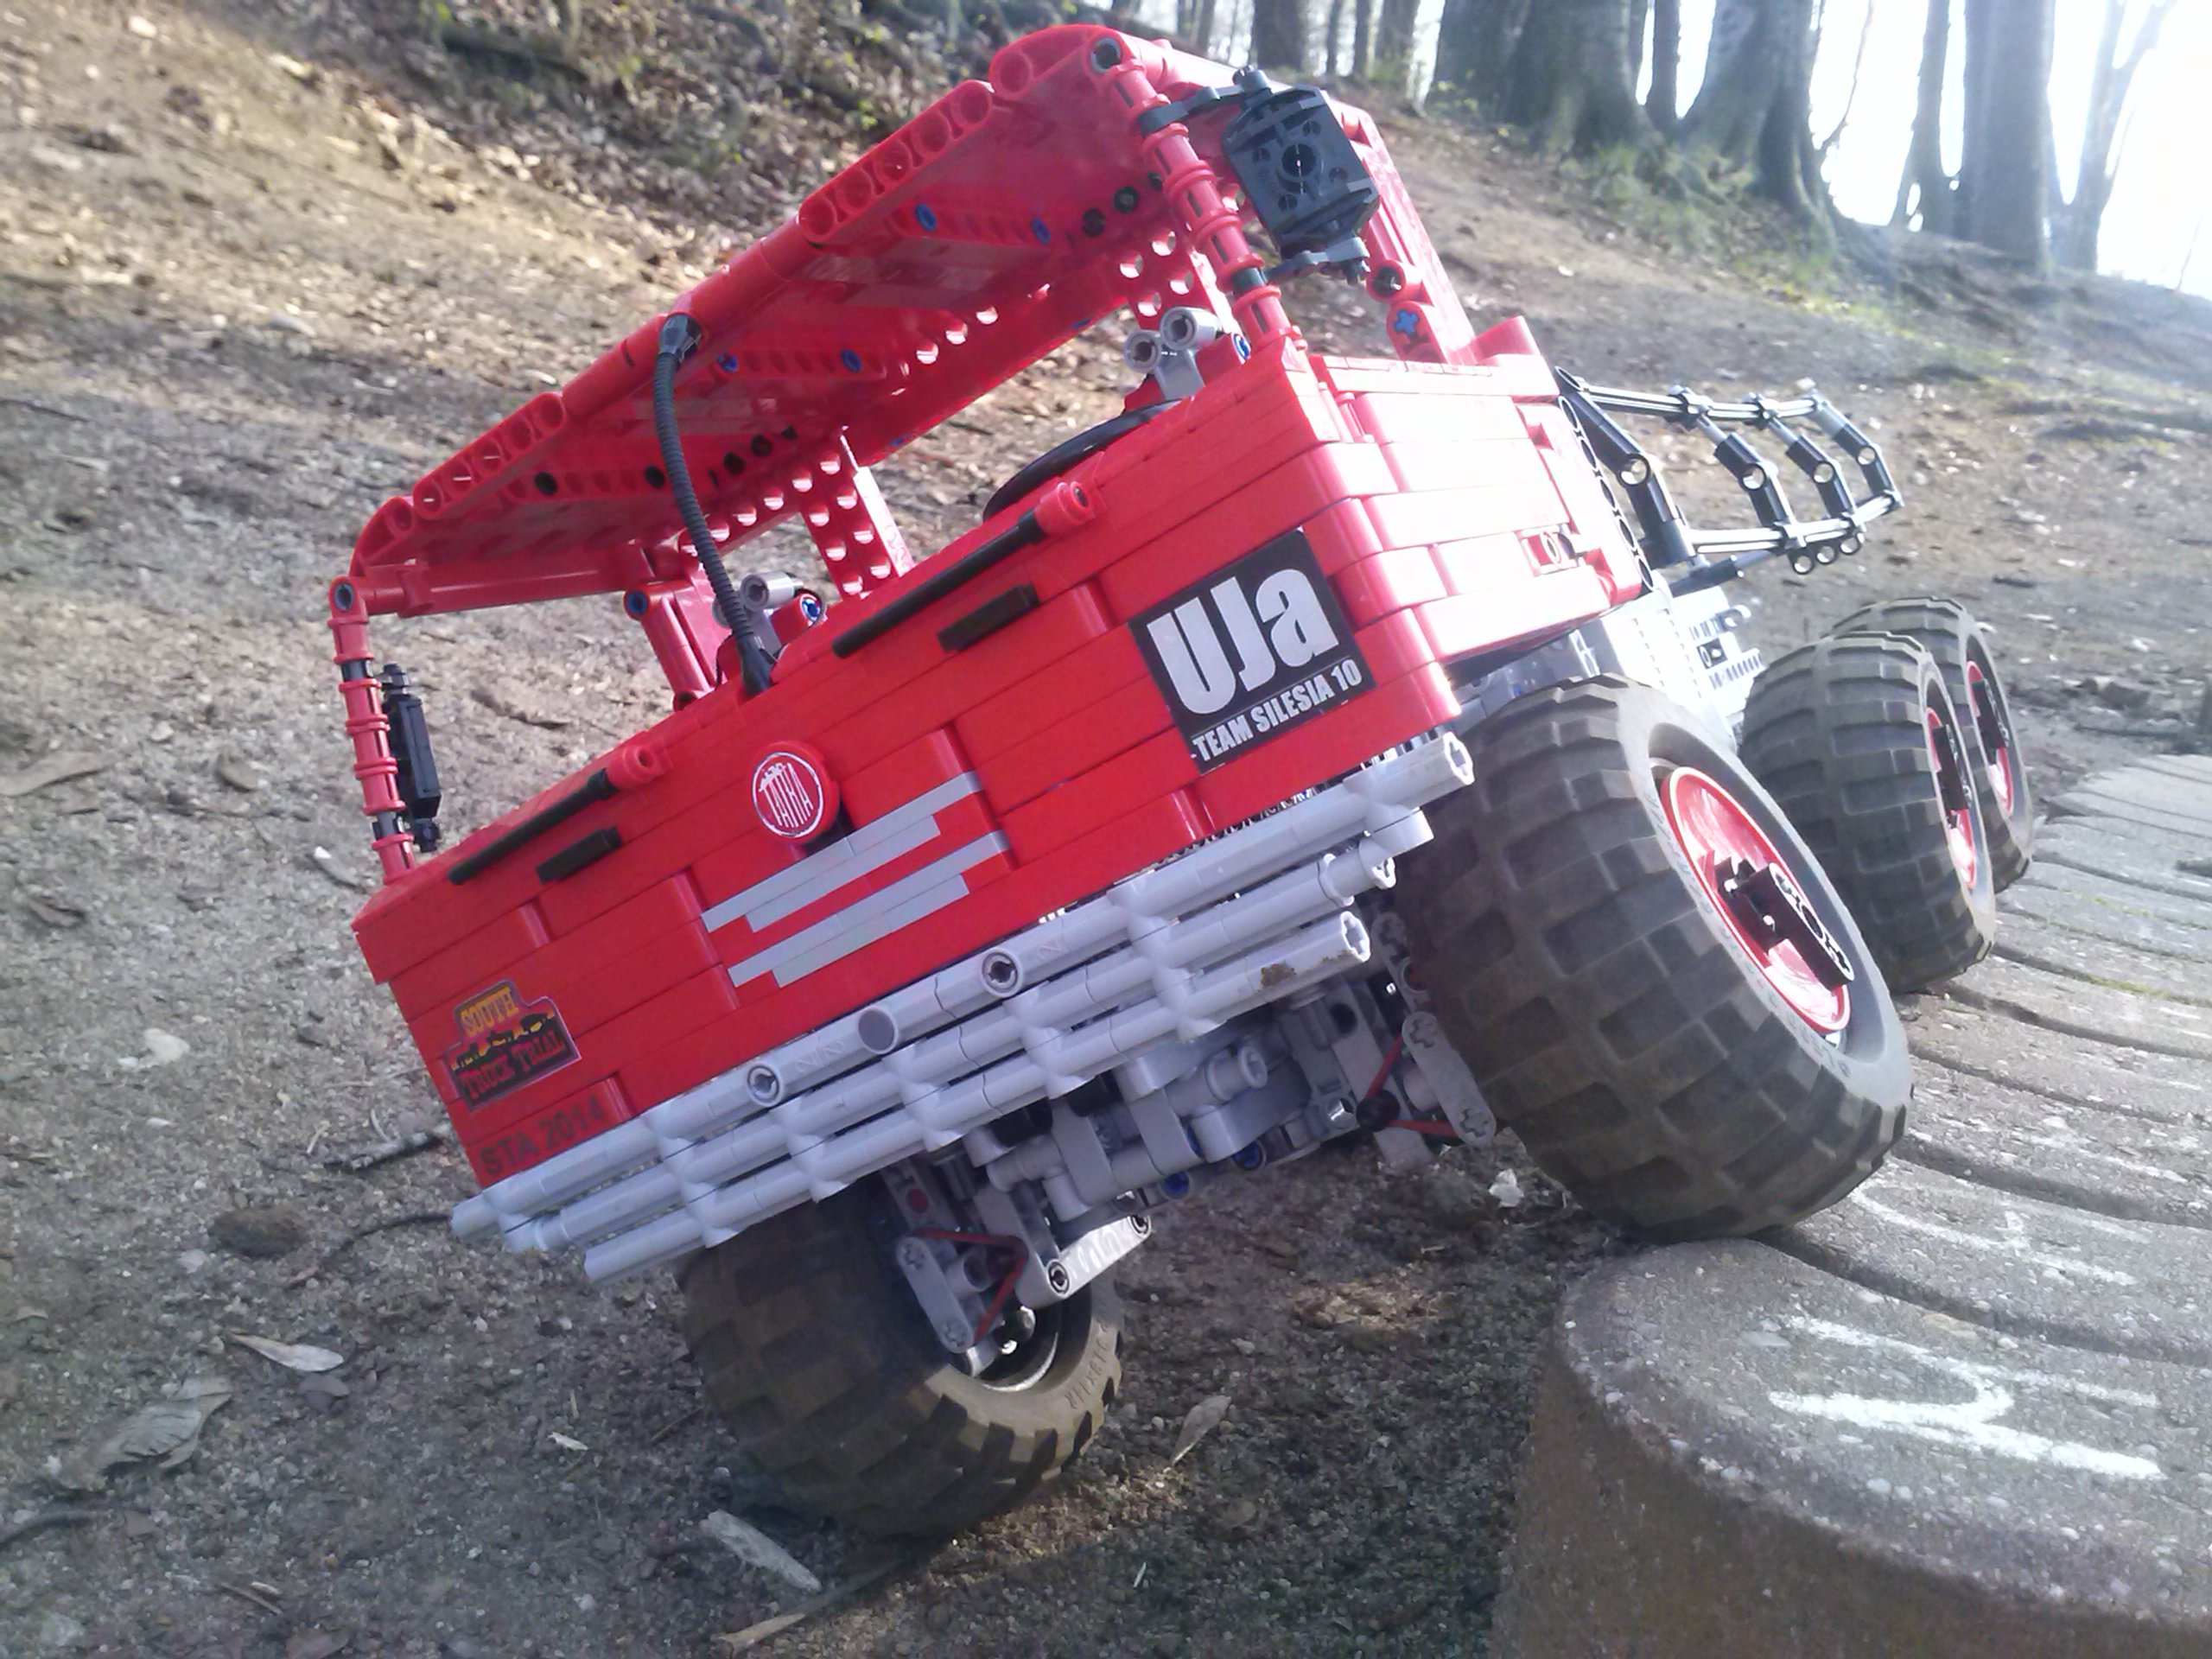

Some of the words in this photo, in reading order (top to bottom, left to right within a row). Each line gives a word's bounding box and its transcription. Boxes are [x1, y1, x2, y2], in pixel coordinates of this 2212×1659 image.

[1147, 569, 1338, 714] UJa
[1192, 715, 1253, 761] TEAM
[1251, 675, 1335, 732] SILESIA
[1331, 659, 1363, 691] 10
[759, 762, 813, 828] TATRA
[460, 986, 518, 1037] SOUTH
[458, 1052, 516, 1099] TRUCK
[512, 1028, 567, 1072] TRIAL
[480, 1131, 537, 1174] STA
[539, 1094, 605, 1147] 2014
